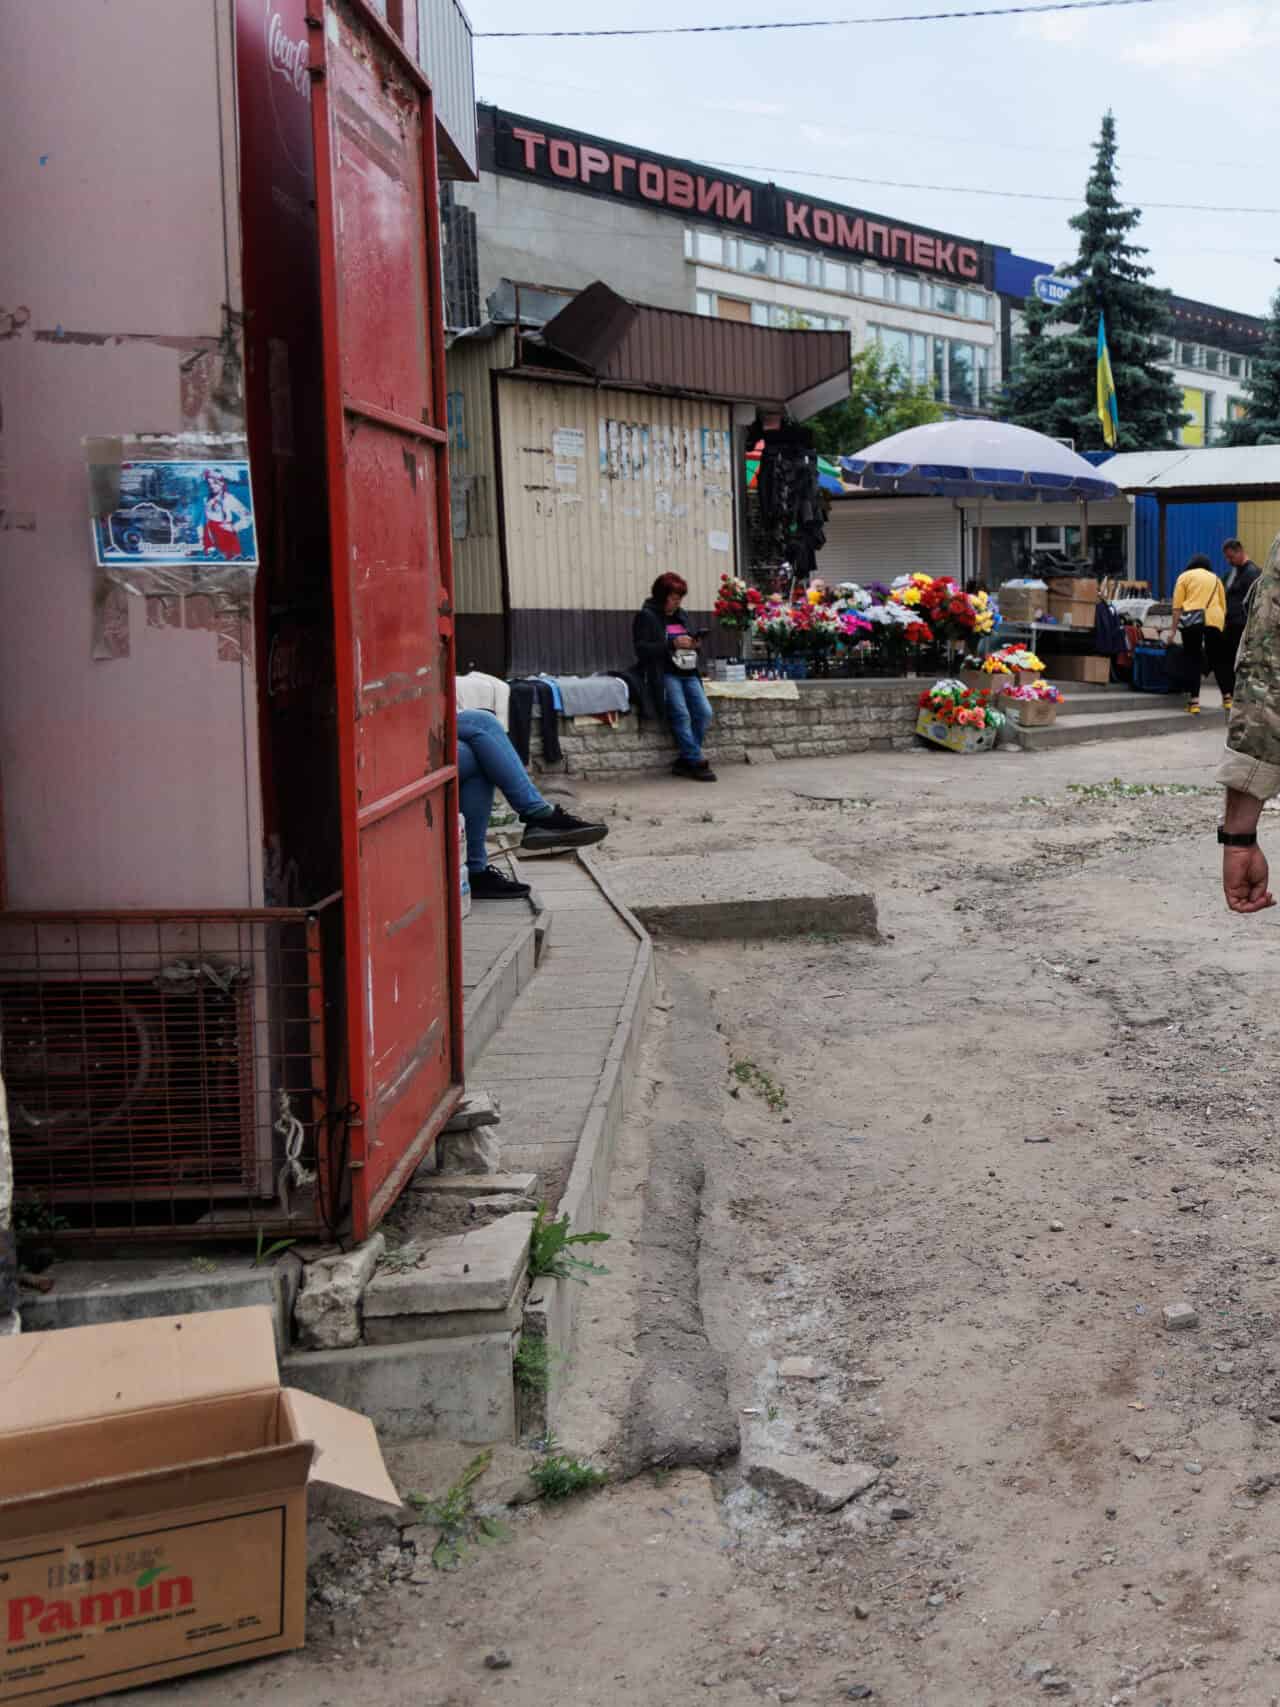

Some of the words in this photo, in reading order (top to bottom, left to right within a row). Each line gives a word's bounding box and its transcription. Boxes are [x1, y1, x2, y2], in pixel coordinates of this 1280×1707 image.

[512, 127, 753, 225] ТОРГОВИЙ
[784, 200, 978, 278] КОМПЛЕКС
[7, 1566, 194, 1643] Pamin
